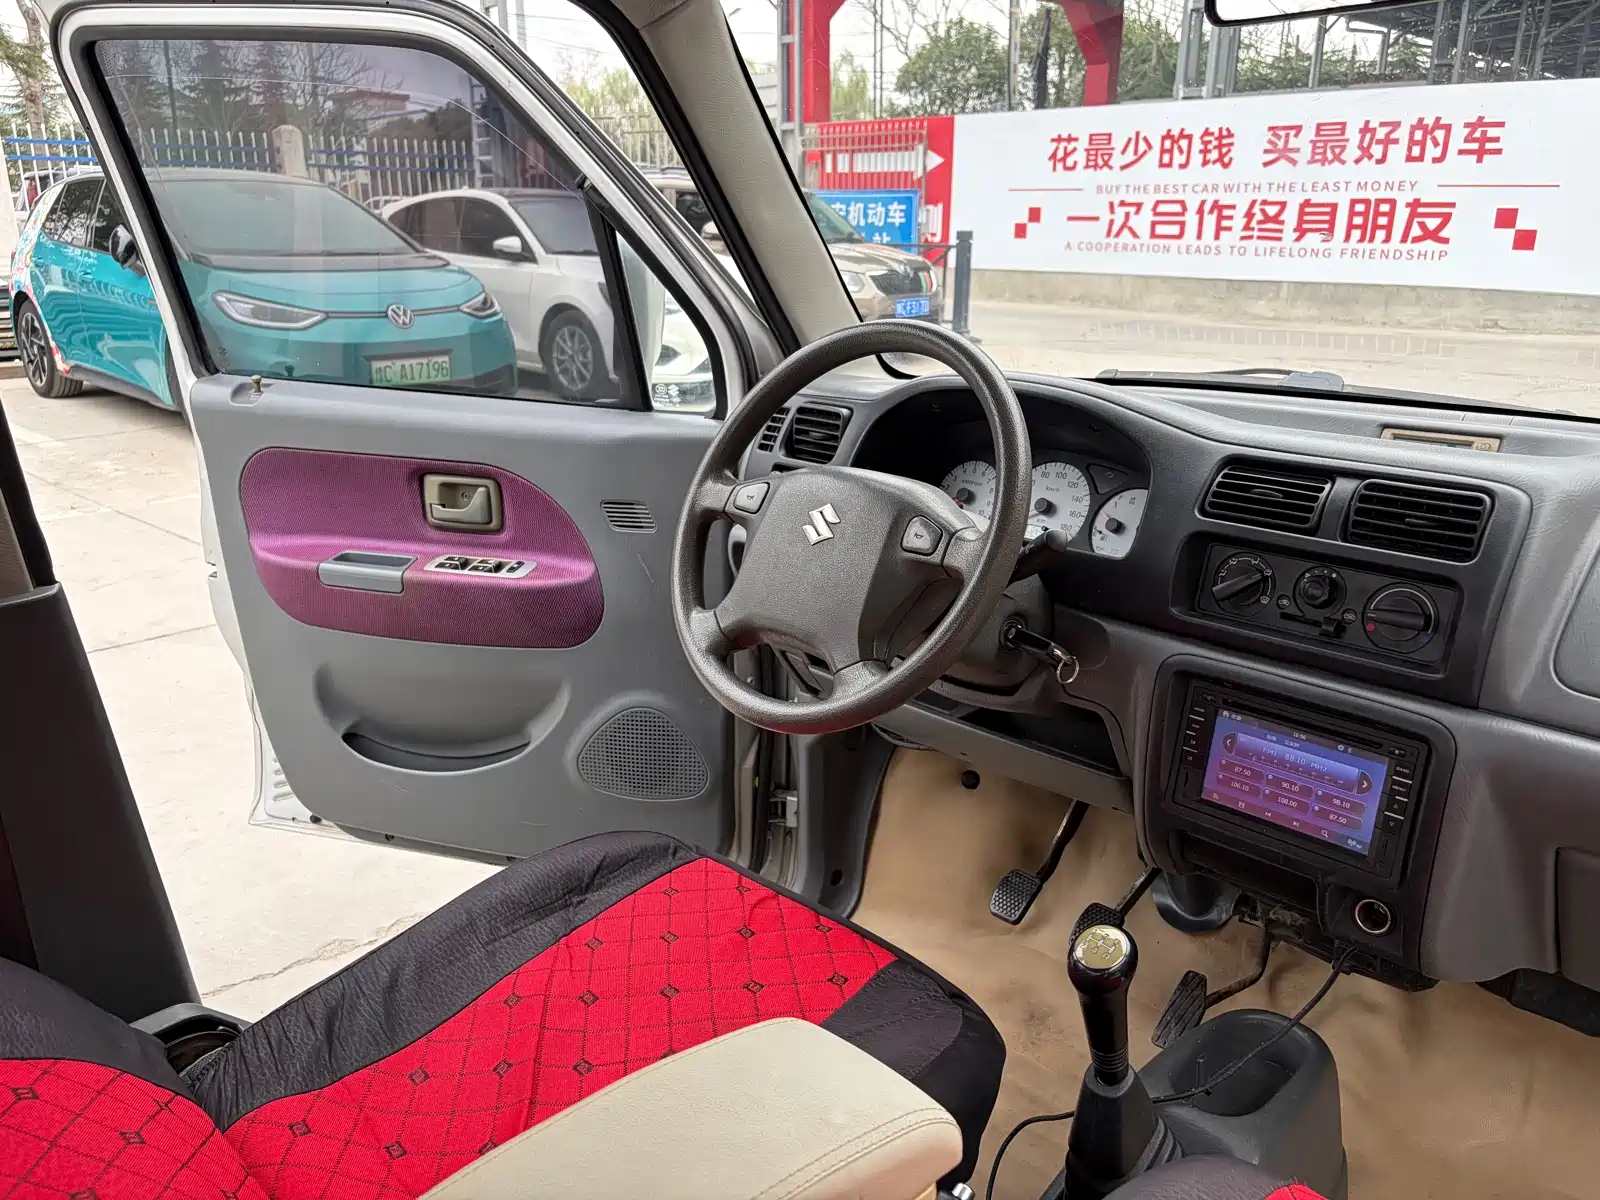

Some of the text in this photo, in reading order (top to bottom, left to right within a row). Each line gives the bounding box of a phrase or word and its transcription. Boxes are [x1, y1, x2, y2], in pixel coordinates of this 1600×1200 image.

[1047, 115, 1507, 173] 花最少的钱 买最好的车
[1096, 180, 1418, 195] BUY THE BEST CAR WITH THE LEAST MONEY
[1066, 197, 1457, 245] 一次合作终身朋友
[1064, 241, 1449, 262] A COOPERATION LEADS TO LIFELONG FRIENDSHIP
[1055, 471, 1068, 480] 100
[1067, 481, 1079, 489] 120
[1071, 495, 1084, 503] 140
[1069, 510, 1082, 518] 160
[1060, 523, 1073, 531] 180
[1284, 753, 1306, 765] 88.10
[1234, 766, 1251, 777] 87.50
[1281, 781, 1300, 792] 90.10
[1230, 781, 1347, 824] 106.10 108.00 87.50
